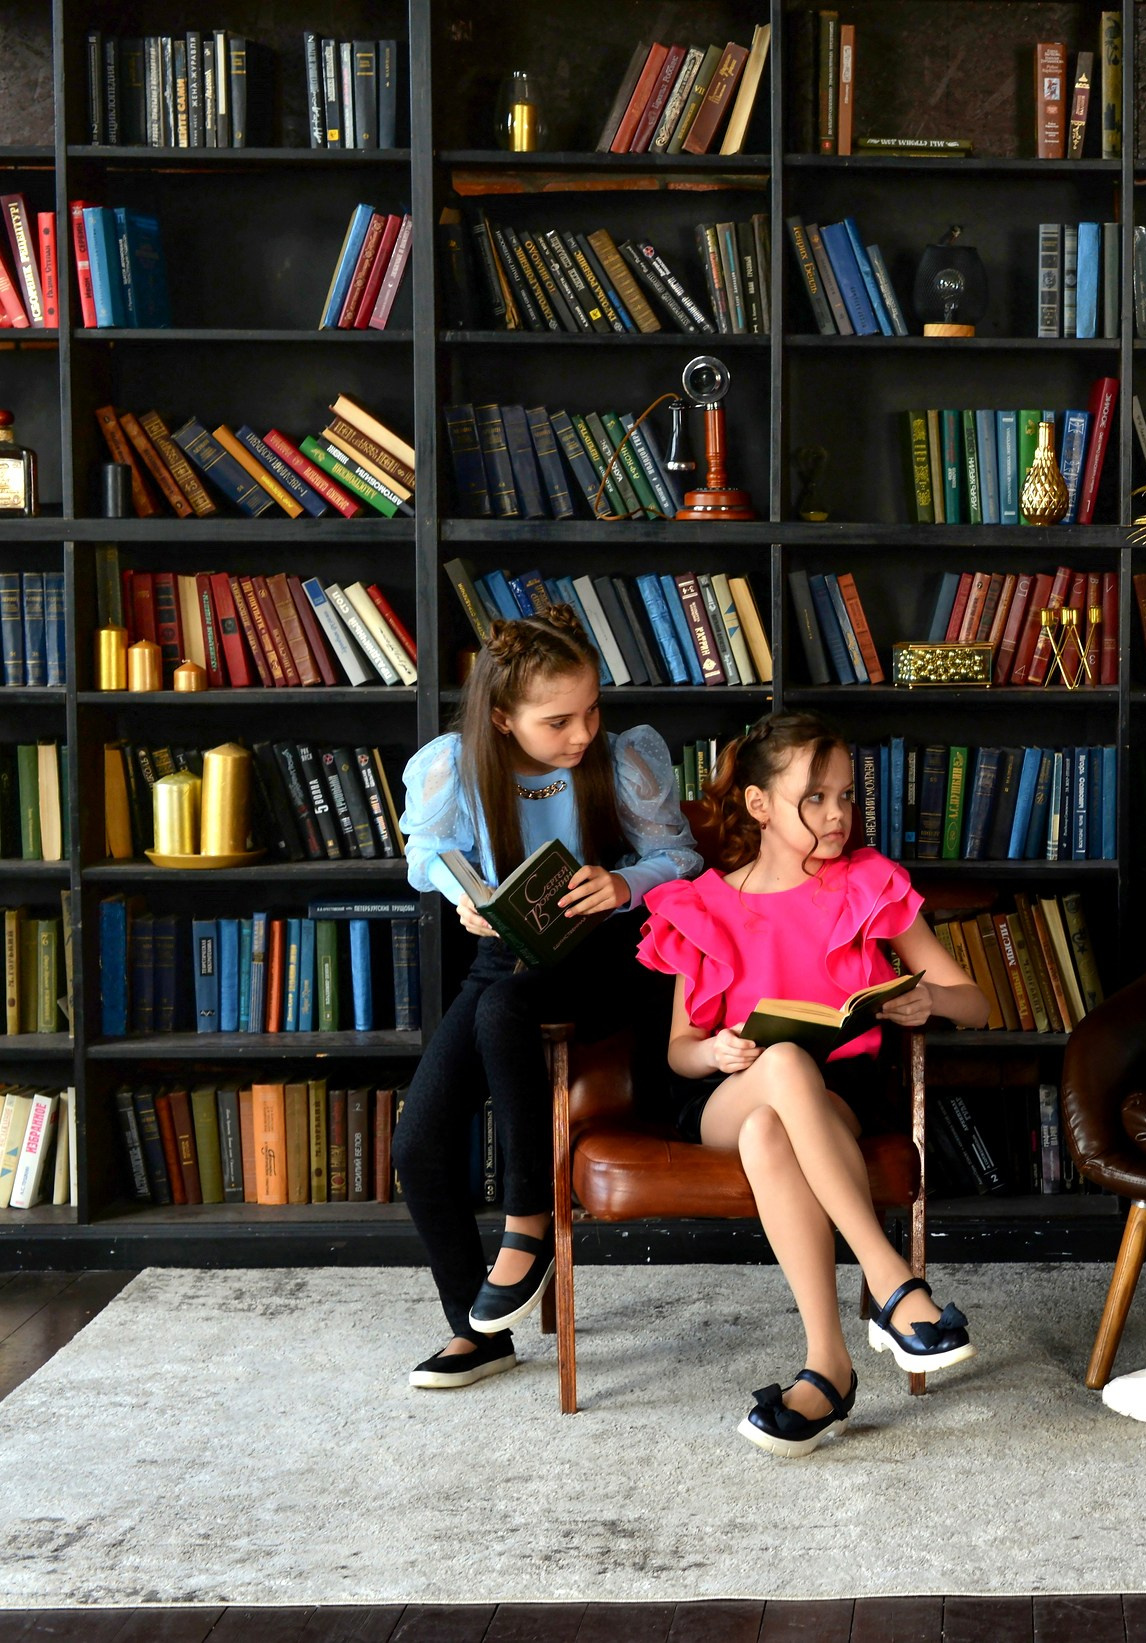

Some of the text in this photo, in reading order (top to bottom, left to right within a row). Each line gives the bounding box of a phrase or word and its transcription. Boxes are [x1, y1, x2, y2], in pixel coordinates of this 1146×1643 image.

[106, 66, 118, 144] ЭНЦИКЛОПЕДИЯ
[176, 79, 188, 112] САМИ
[9, 205, 42, 317] СБОРНИК РЕЦЕПТУР
[76, 222, 92, 299] Иван СЕРБИН
[793, 225, 810, 260] Генрих
[514, 245, 554, 320] ГАРОЛЬД РОББИНС
[744, 255, 754, 278] ГРОЗНЫЙ
[574, 249, 616, 322] ГАРОЛЬД РОББИНС
[1099, 392, 1113, 429] ЭКОНОМИКС
[246, 432, 276, 464] МОУРАВИ
[637, 445, 656, 475] МОЛОДОЙ
[354, 465, 403, 507] АВТОМОБИЛИ
[201, 593, 212, 625] РЕЦЕПТЫ
[246, 590, 265, 631] МАРИАННА
[330, 589, 351, 615] СТОЛ
[456, 581, 477, 618] ОТРАВЛЕНИЯ
[346, 615, 393, 681] ПРАЗДНИЧНЫЙ
[693, 625, 711, 656] КАТРИН
[1077, 754, 1085, 774] Игорь
[309, 778, 329, 815] 5 ВОЛНА
[863, 758, 877, 833] ВЕЛИКИЙ МОУРАВИ
[948, 766, 963, 820] А.С.ПУШКИН
[998, 922, 1016, 967] МЫСЛИ
[949, 1098, 969, 1132] АРХИПЕЛАГ
[954, 1093, 971, 1121] ГУЛАГ
[24, 1101, 48, 1154] ИЗБРАННОЕ
[353, 1132, 362, 1192] ВАСИЛИЙ БЕЛОВ
[989, 1173, 999, 1183] 2
